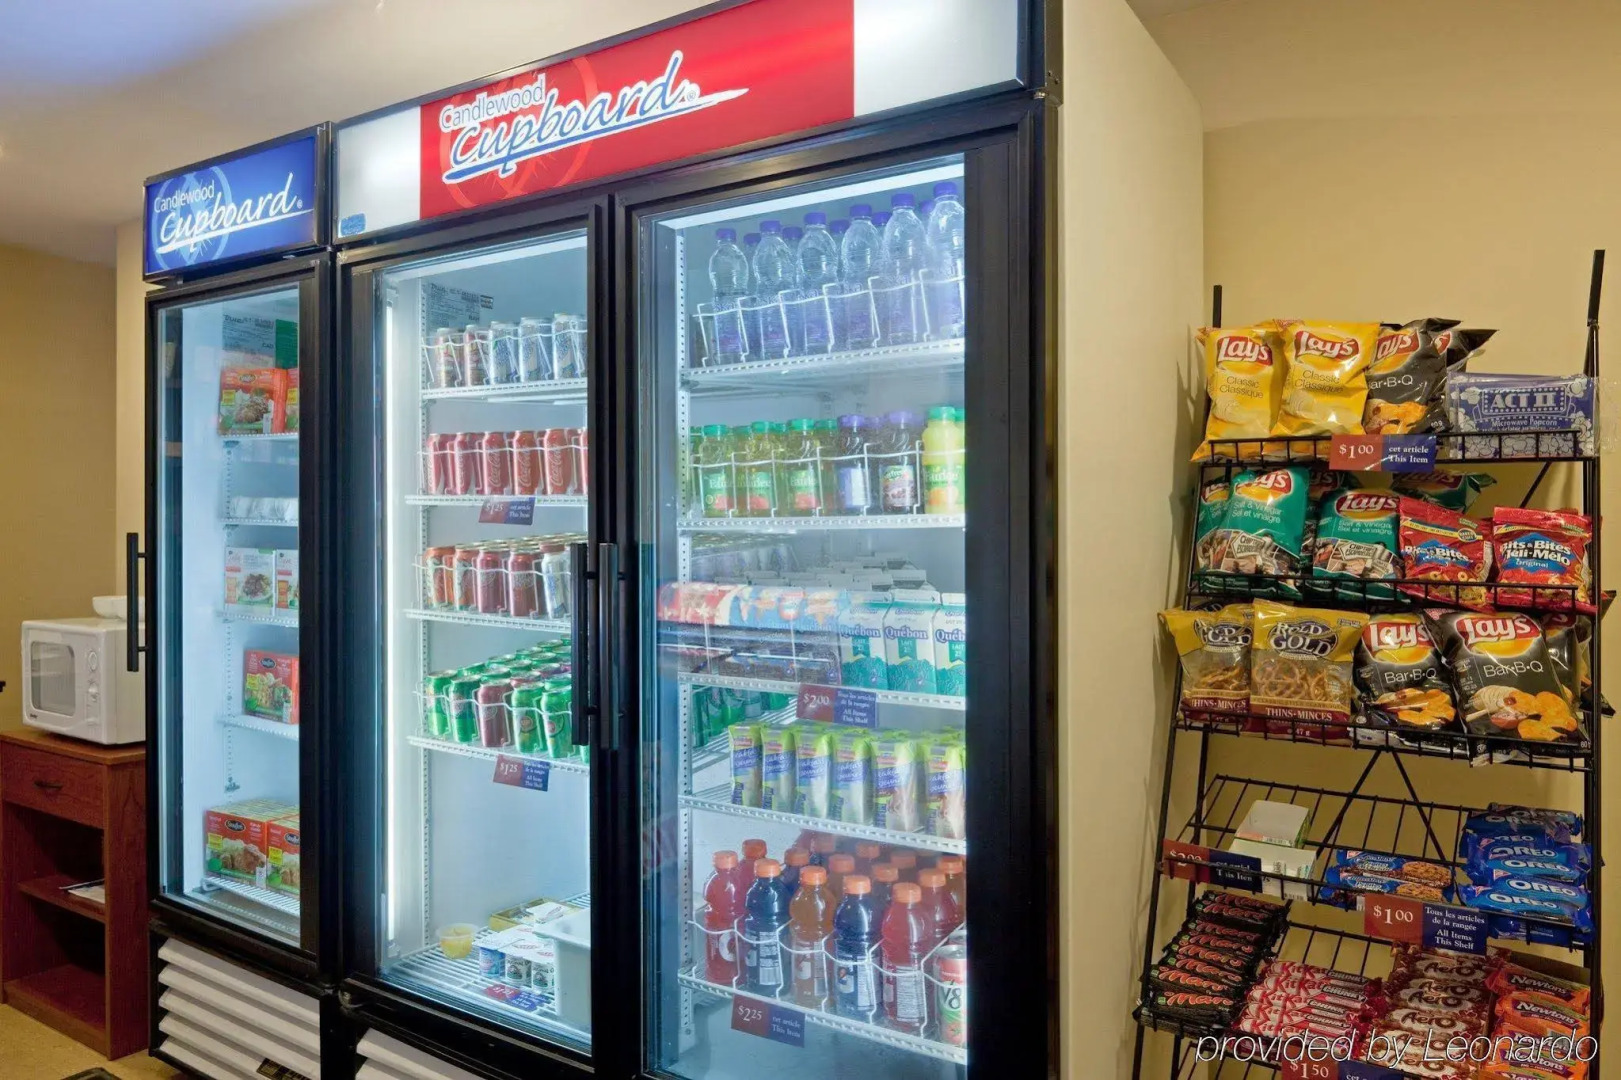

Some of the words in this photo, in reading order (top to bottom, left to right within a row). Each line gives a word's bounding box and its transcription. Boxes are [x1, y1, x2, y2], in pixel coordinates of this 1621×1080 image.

[442, 75, 545, 130] Candlewood
[451, 53, 692, 174] Cupboard
[153, 179, 215, 213] Candlewood
[160, 172, 298, 253] Cupboard
[1226, 375, 1259, 389] Classic
[1302, 369, 1340, 384] Classic
[1219, 384, 1264, 399] Classique
[1294, 378, 1344, 393] Classique
[1490, 392, 1530, 410] ACT
[1533, 391, 1558, 408] II
[1491, 417, 1528, 428] Microwave
[1529, 417, 1558, 429] Popcorn
[1388, 446, 1401, 454] cet
[1403, 445, 1430, 454] article
[1388, 454, 1407, 463] This
[1409, 455, 1429, 464] Item
[1243, 510, 1252, 518] et
[1533, 540, 1572, 556] Bites
[885, 625, 928, 640] Québon
[936, 628, 966, 643] Québ
[1269, 633, 1332, 658] GOLD
[1504, 859, 1570, 872] OREO
[1508, 880, 1577, 897] OREO
[1489, 893, 1558, 908] OREO
[1425, 906, 1444, 918] Tous
[1445, 909, 1456, 919] les
[1457, 911, 1485, 924] articles
[1443, 918, 1451, 926] la
[1452, 921, 1477, 931] rangée
[1437, 928, 1449, 937] All
[1451, 930, 1472, 941] Items
[1434, 936, 1453, 946] This
[1454, 938, 1475, 950] Shelf
[1510, 974, 1568, 995] Newtons
[1167, 993, 1234, 1006] Mars
[1324, 985, 1367, 1002] CHUNKY
[1309, 1000, 1346, 1015] CHUNK
[1516, 1000, 1576, 1025] Newtons
[1400, 1011, 1458, 1028] Aero
